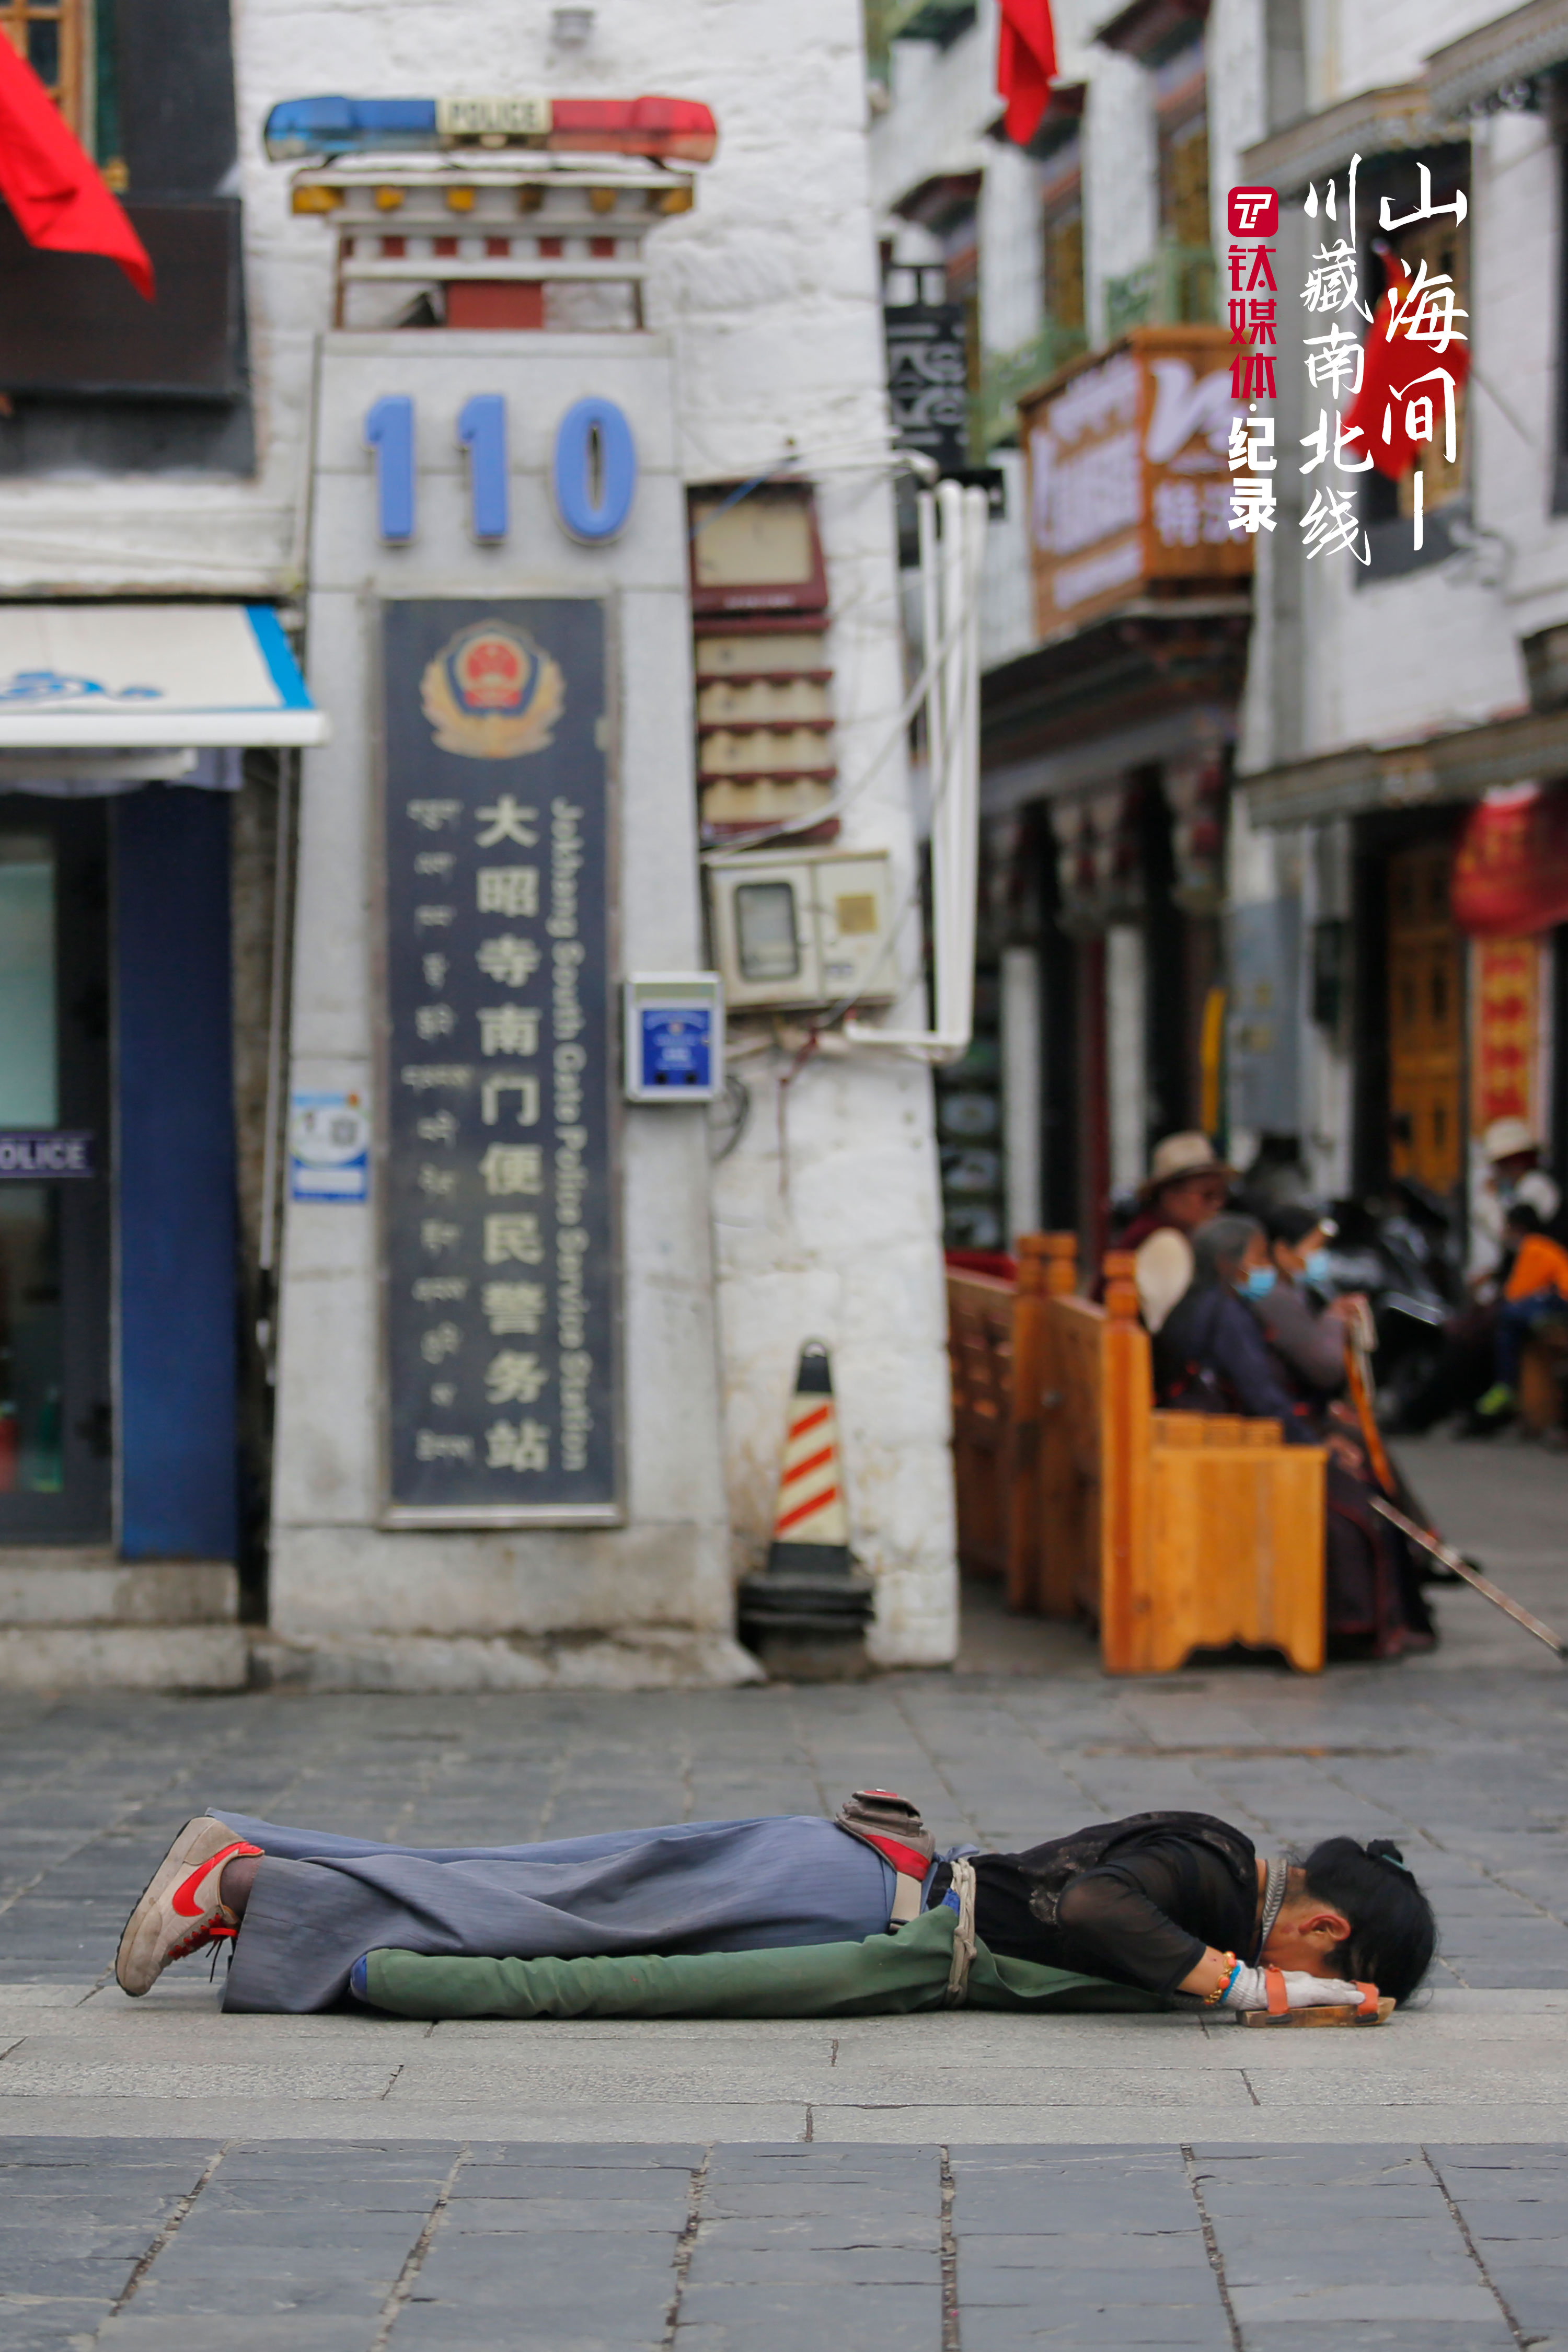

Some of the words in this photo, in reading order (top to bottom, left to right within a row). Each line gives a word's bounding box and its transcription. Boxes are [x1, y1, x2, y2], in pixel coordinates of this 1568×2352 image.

[451, 101, 538, 130] POLICE
[364, 394, 638, 542] 110
[474, 793, 551, 1473] 大昭寺南门便民警务站
